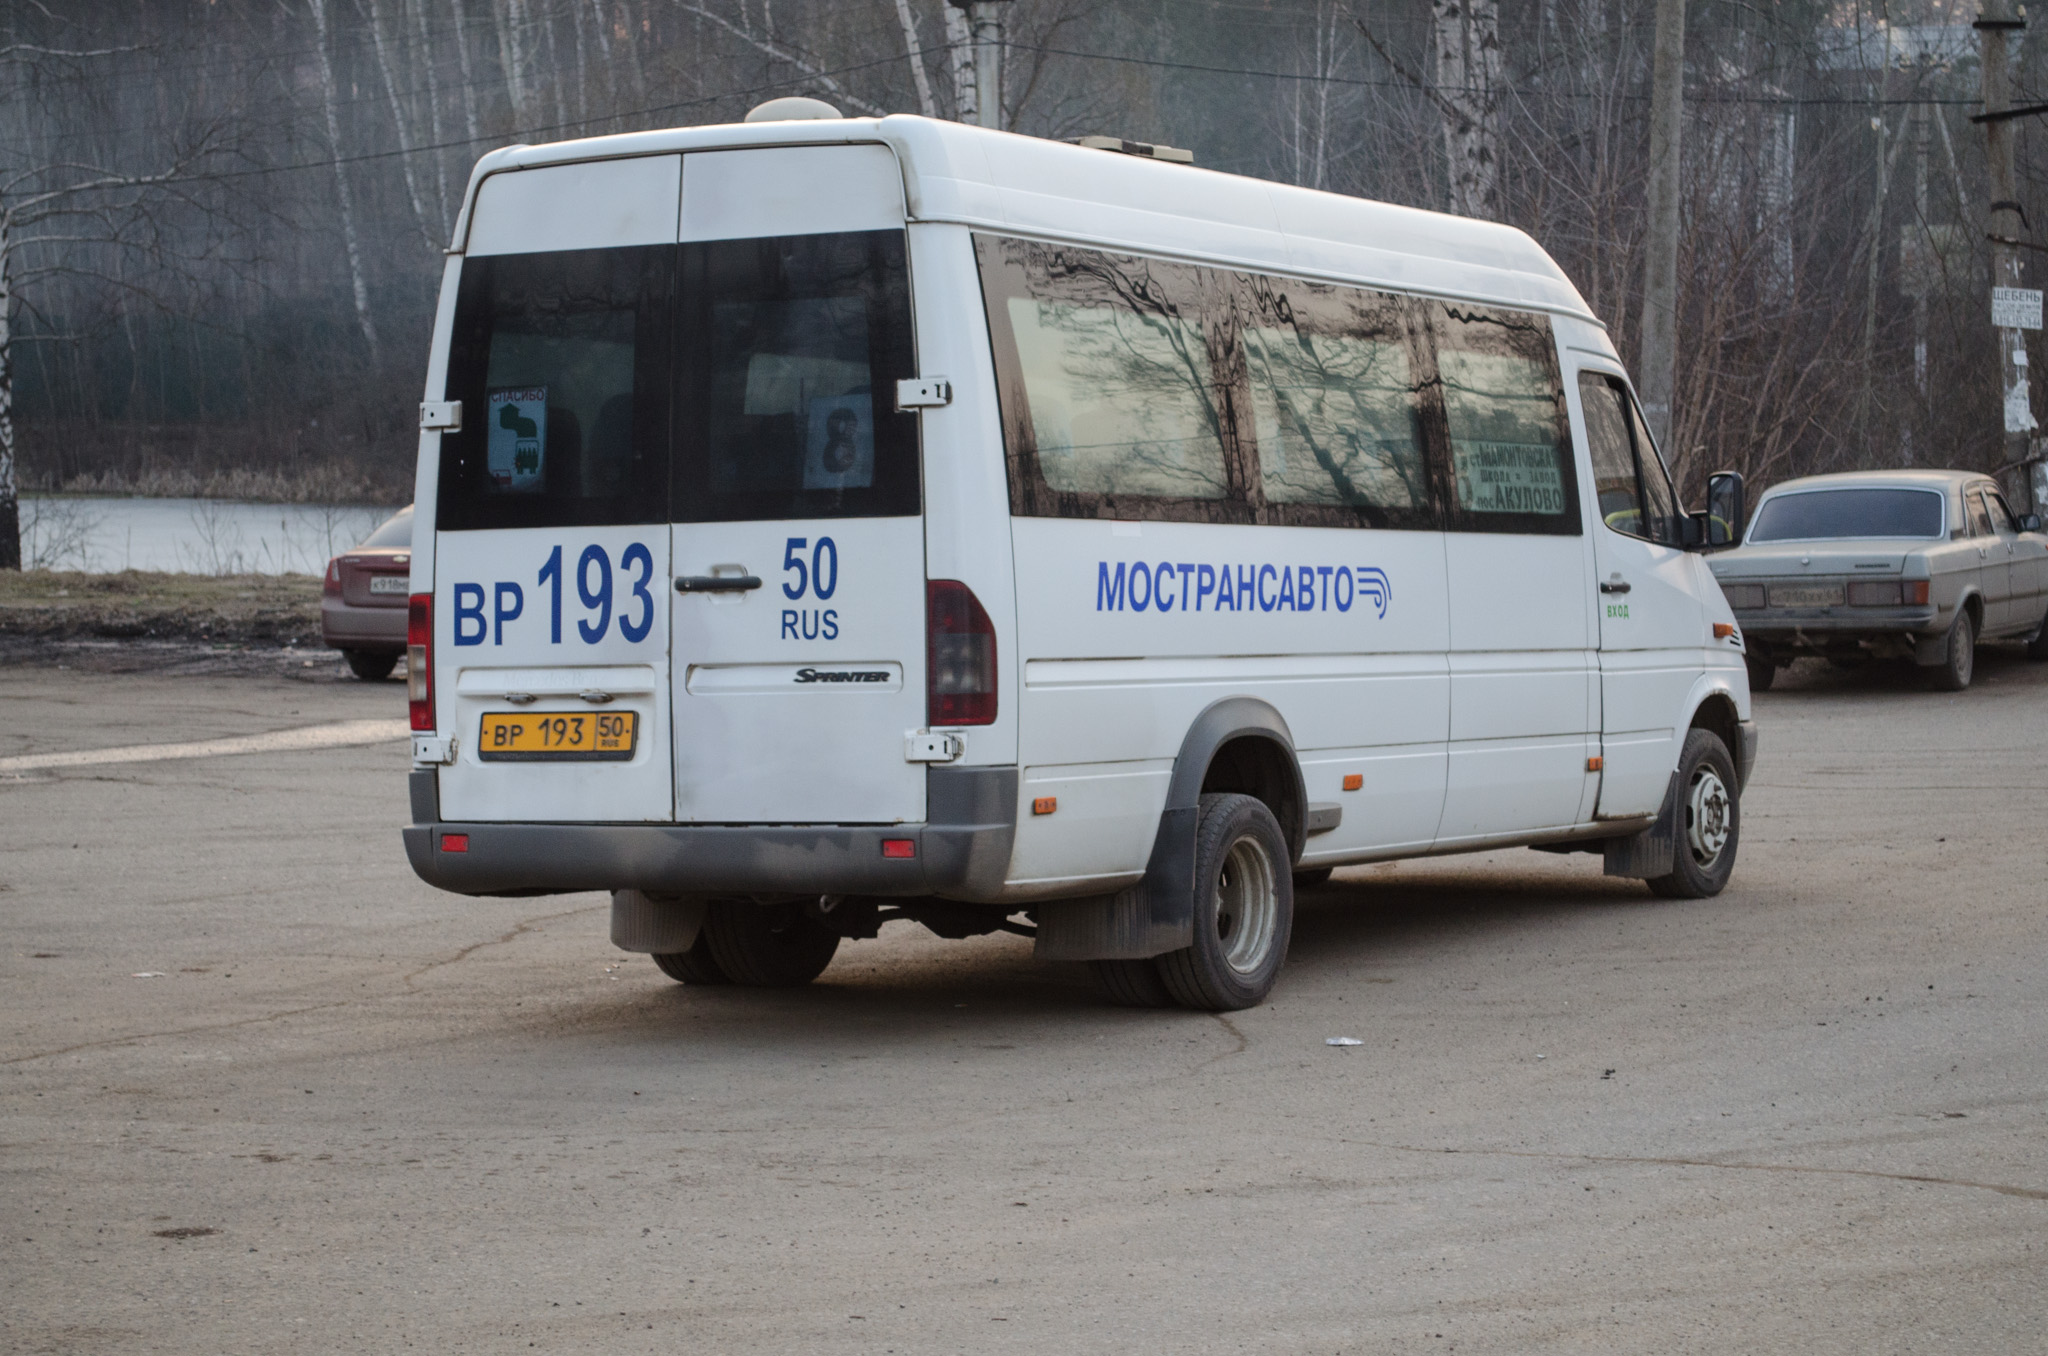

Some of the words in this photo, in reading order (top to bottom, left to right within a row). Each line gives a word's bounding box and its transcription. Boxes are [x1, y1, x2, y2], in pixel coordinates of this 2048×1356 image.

[491, 389, 545, 403] СПАСИБО
[822, 407, 858, 473] 8
[1495, 484, 1562, 511] АКУЛОВО
[781, 536, 838, 601] 50
[453, 581, 524, 647] ВР
[538, 542, 655, 645] 193
[1096, 561, 1355, 613] МОСТРАНСАВТО
[781, 609, 839, 641] RUS
[1607, 605, 1629, 619] ВХОД
[793, 668, 890, 683] SPRINTER
[494, 725, 524, 746] ВР
[538, 718, 584, 746] 193
[598, 716, 624, 737] 50
[601, 739, 620, 747] RUS
